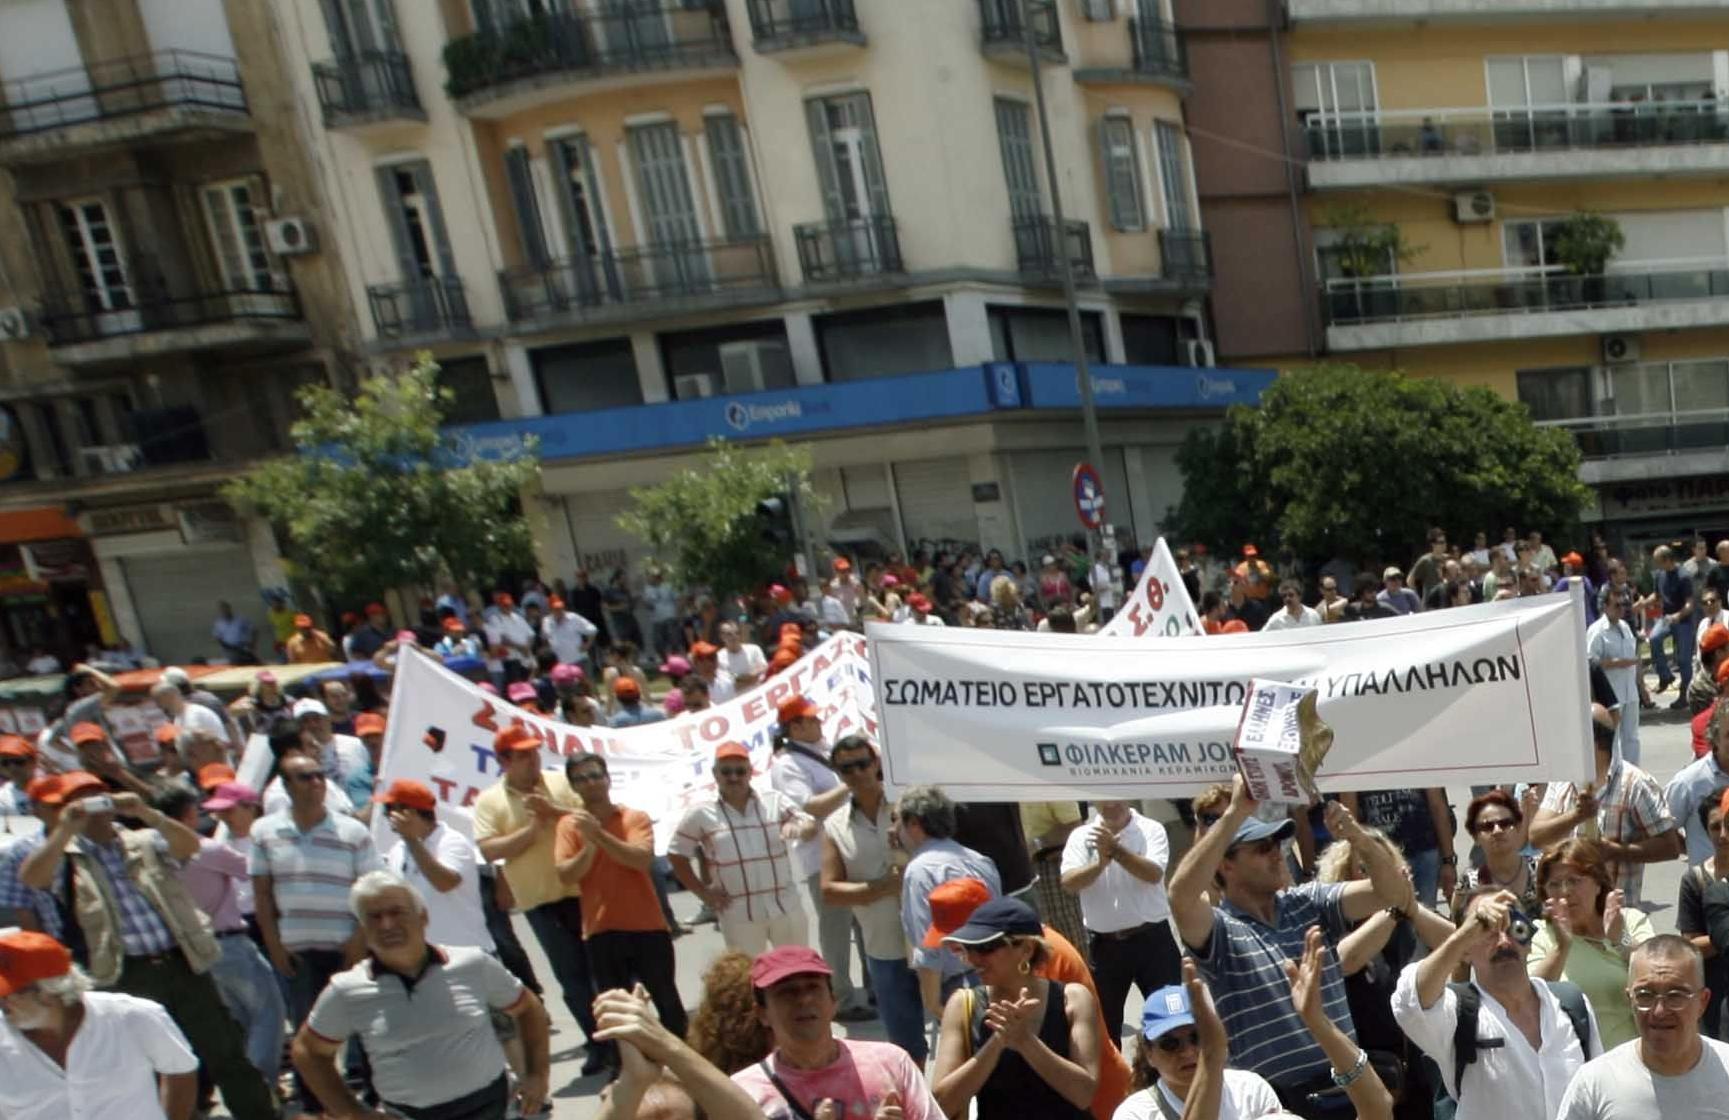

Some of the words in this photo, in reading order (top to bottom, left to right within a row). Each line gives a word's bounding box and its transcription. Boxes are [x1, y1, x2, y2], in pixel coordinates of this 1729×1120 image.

[884, 679, 1017, 706] ΣΩΜΑΤΕΙΟ
[1025, 680, 1245, 708] ΕΡΓΑΤΟΤΕΧΝΙΤΩ
[1327, 654, 1520, 698] ΥΠΑΛΛΗΛΩΝ
[1065, 743, 1191, 765] ΦΙΛΚΕΡΑΜ
